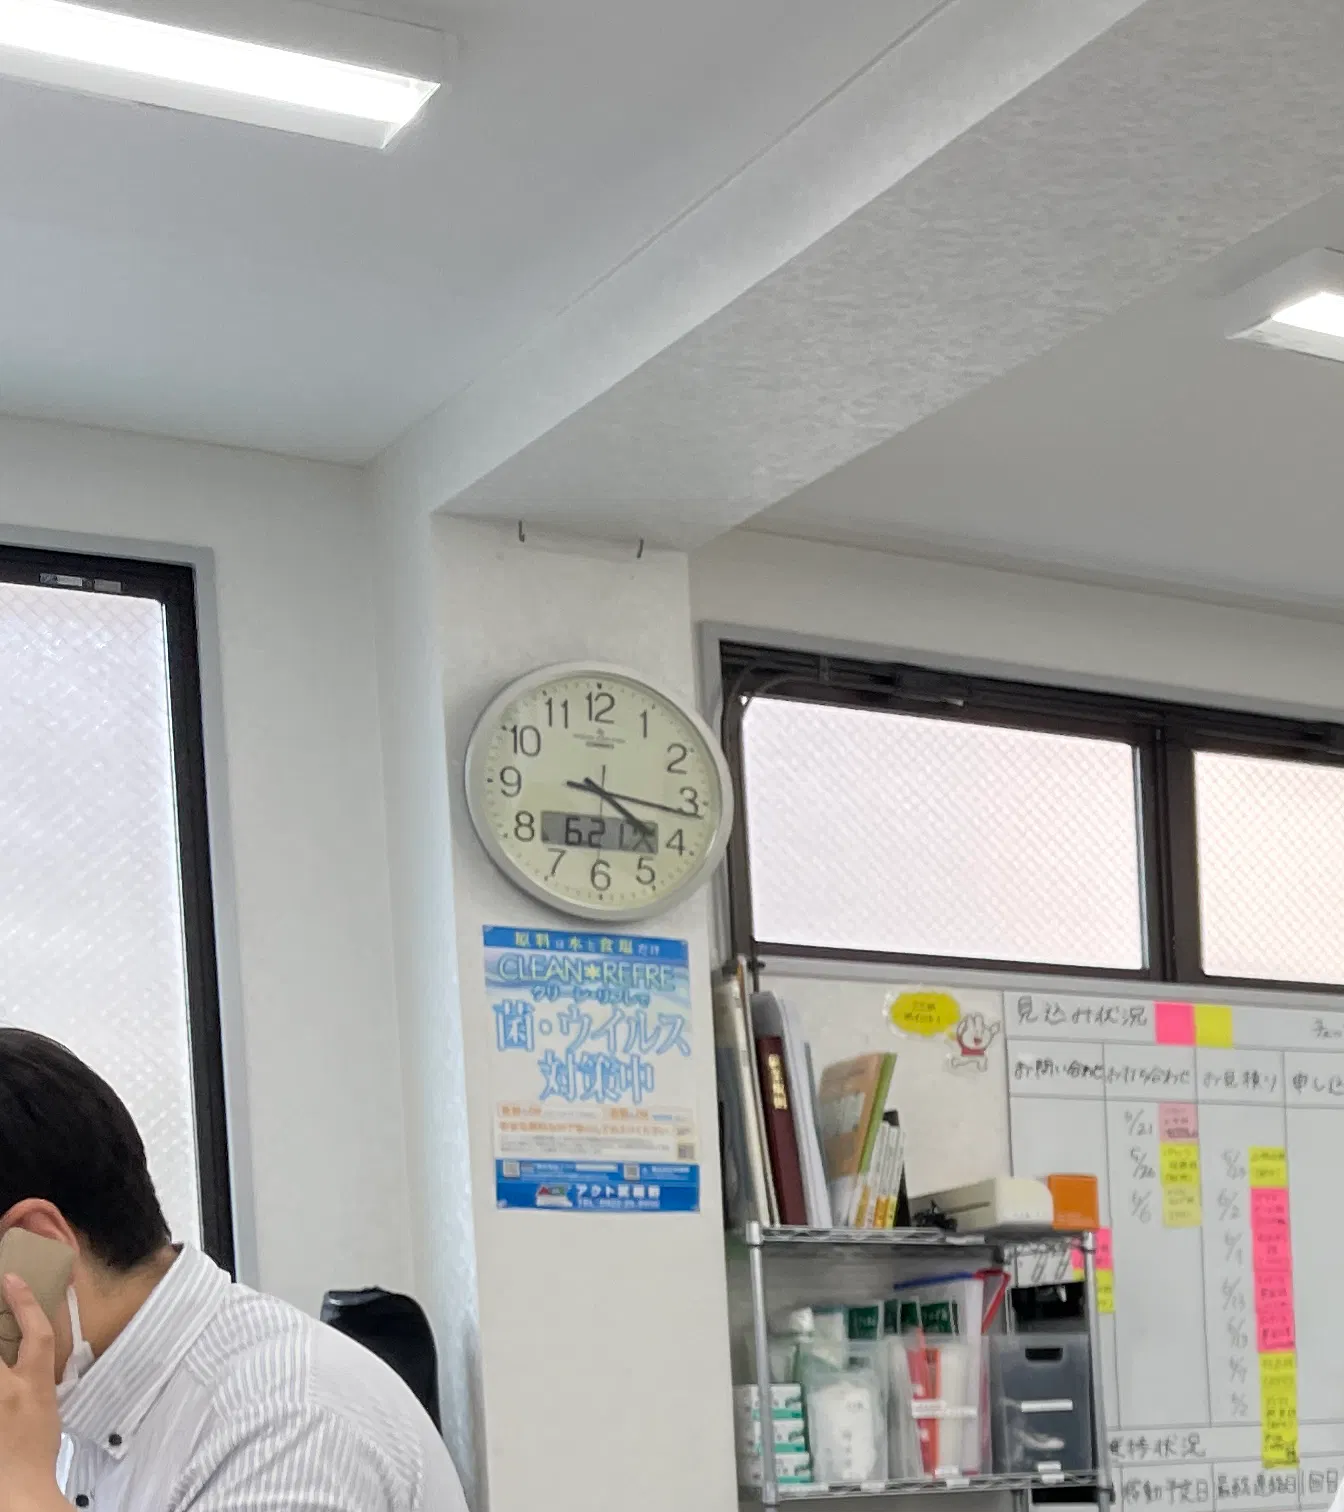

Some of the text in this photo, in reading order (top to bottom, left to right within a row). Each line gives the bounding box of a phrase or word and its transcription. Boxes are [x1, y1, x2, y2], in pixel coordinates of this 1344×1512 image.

[546, 697, 569, 729] 11
[586, 692, 615, 724] 12
[640, 710, 648, 738] 1
[511, 725, 542, 757] 10
[667, 743, 687, 775] 2
[500, 766, 522, 797] 9
[678, 787, 699, 815] 3
[514, 811, 535, 842] 8
[666, 829, 685, 856] 4
[548, 849, 565, 877] 7
[590, 860, 612, 891] 6
[635, 857, 655, 885] 5
[493, 998, 692, 1056] 菌・ウイルス
[538, 1048, 655, 1104] 対策中
